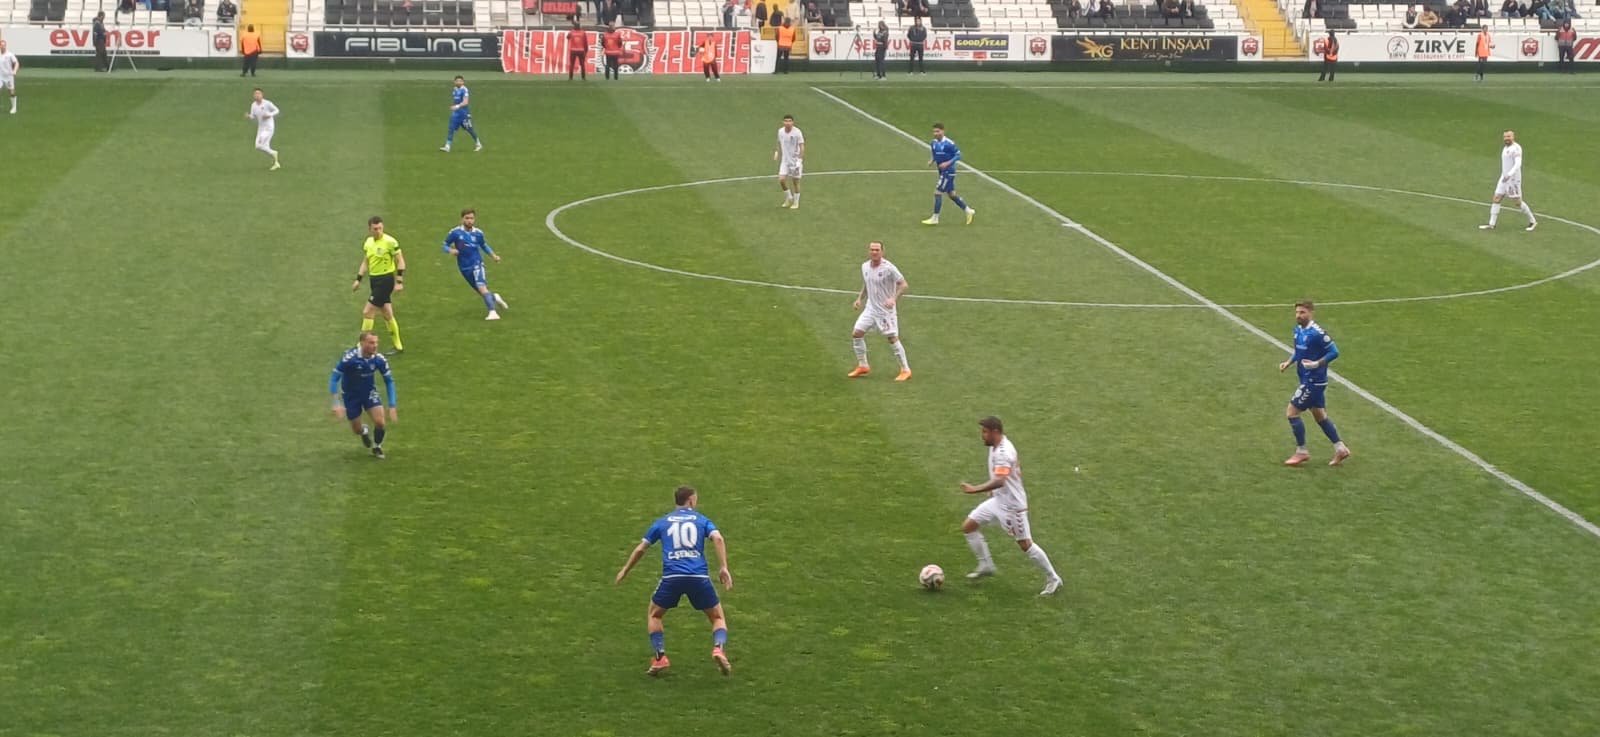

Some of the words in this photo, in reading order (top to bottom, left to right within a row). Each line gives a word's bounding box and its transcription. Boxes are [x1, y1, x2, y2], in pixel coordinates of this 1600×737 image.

[345, 38, 482, 51] FIBLINE
[957, 37, 1007, 47] GOODYEAR
[1120, 38, 1158, 50] KENT
[667, 522, 698, 549] 10
